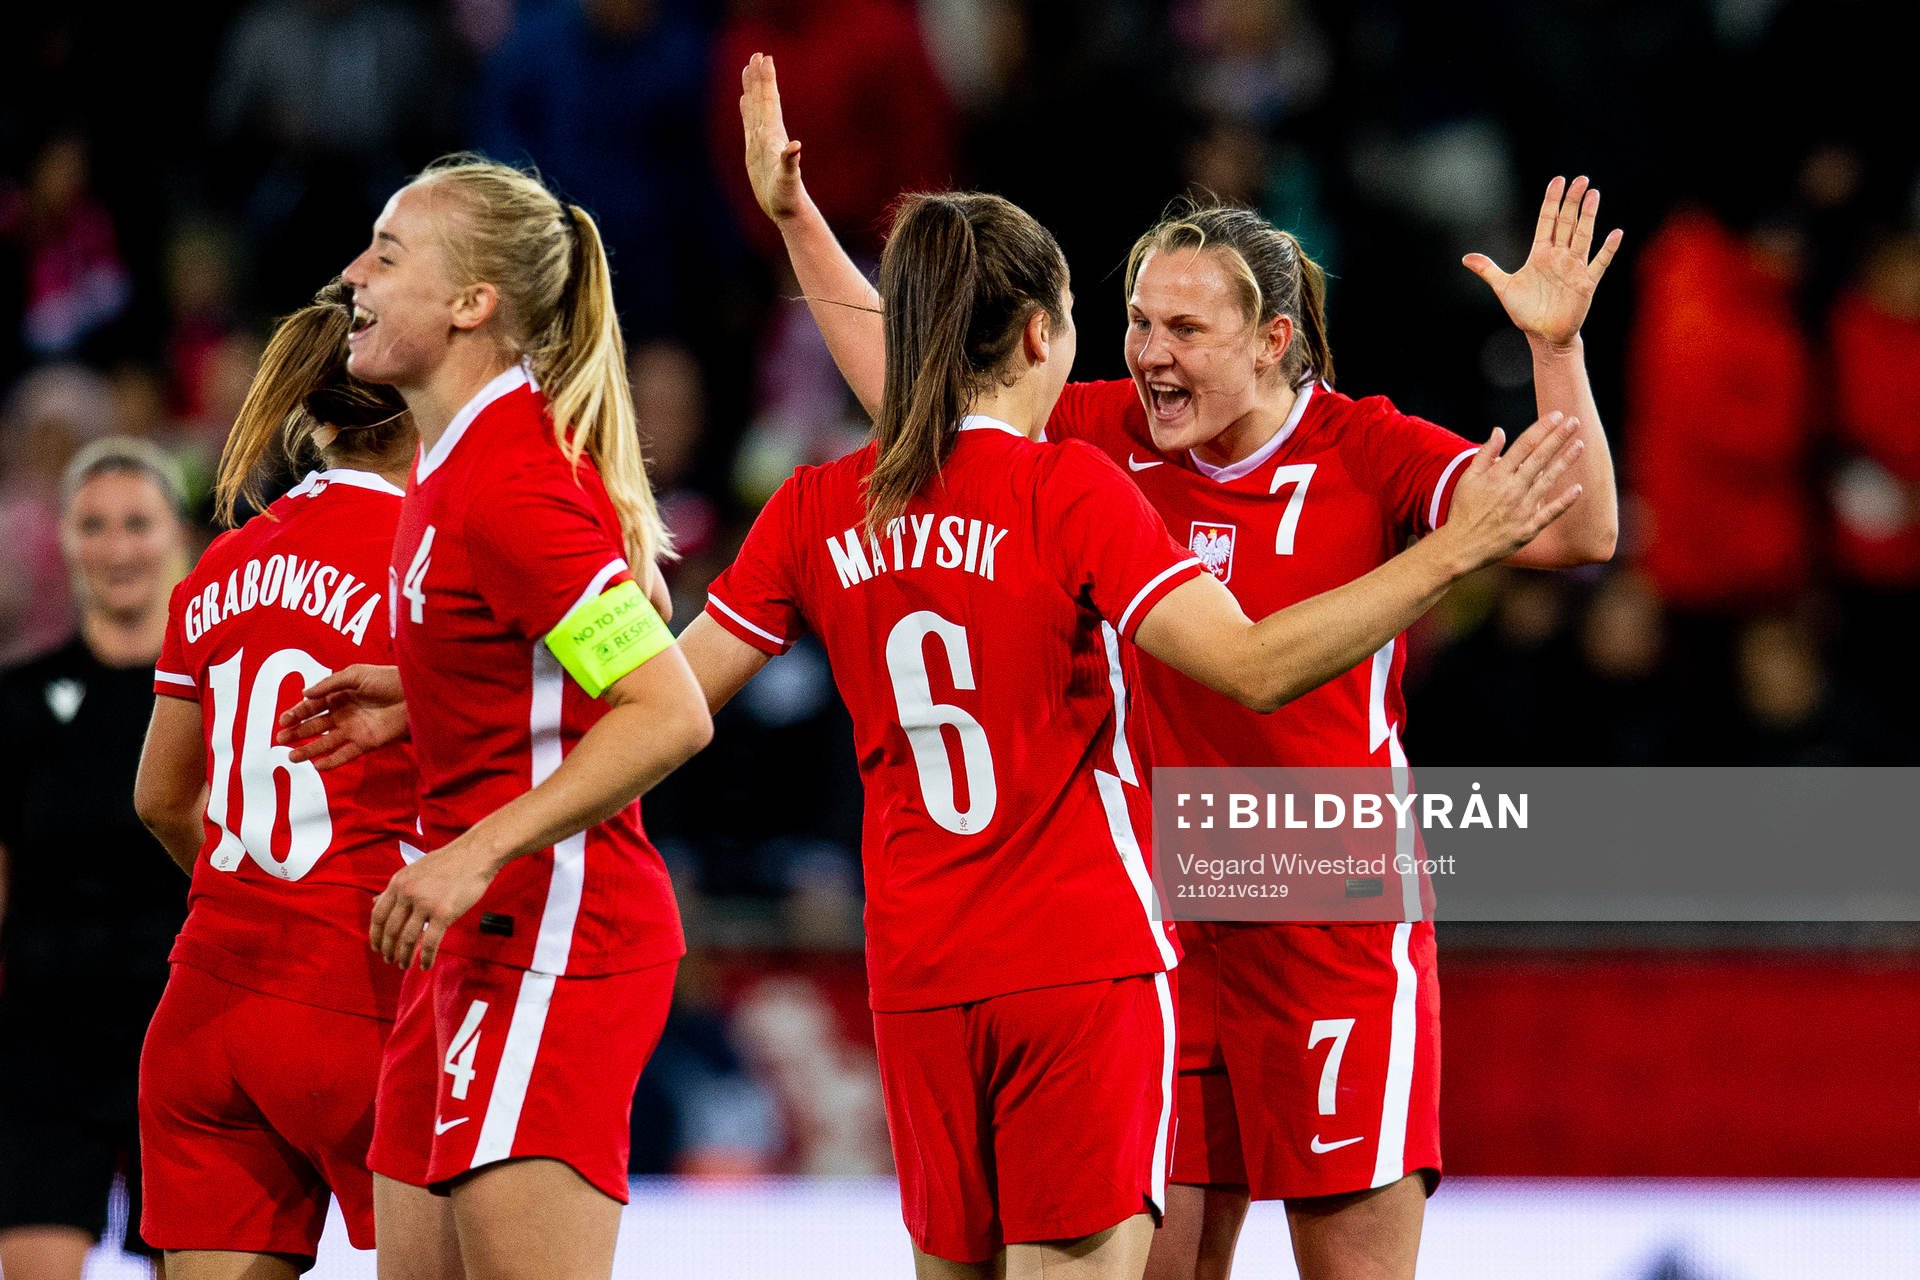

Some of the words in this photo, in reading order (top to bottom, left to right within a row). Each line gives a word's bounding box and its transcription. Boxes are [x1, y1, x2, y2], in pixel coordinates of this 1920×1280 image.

[825, 513, 1009, 590] MATYSIK
[1268, 463, 1318, 556] 7
[185, 554, 382, 647] GRABOWSKA
[402, 524, 436, 624] 4
[572, 625, 595, 646] NO
[592, 612, 615, 630] TO
[207, 646, 333, 882] 16
[885, 610, 998, 836] 6
[443, 999, 489, 1101] 4
[1307, 1018, 1356, 1116] 7
